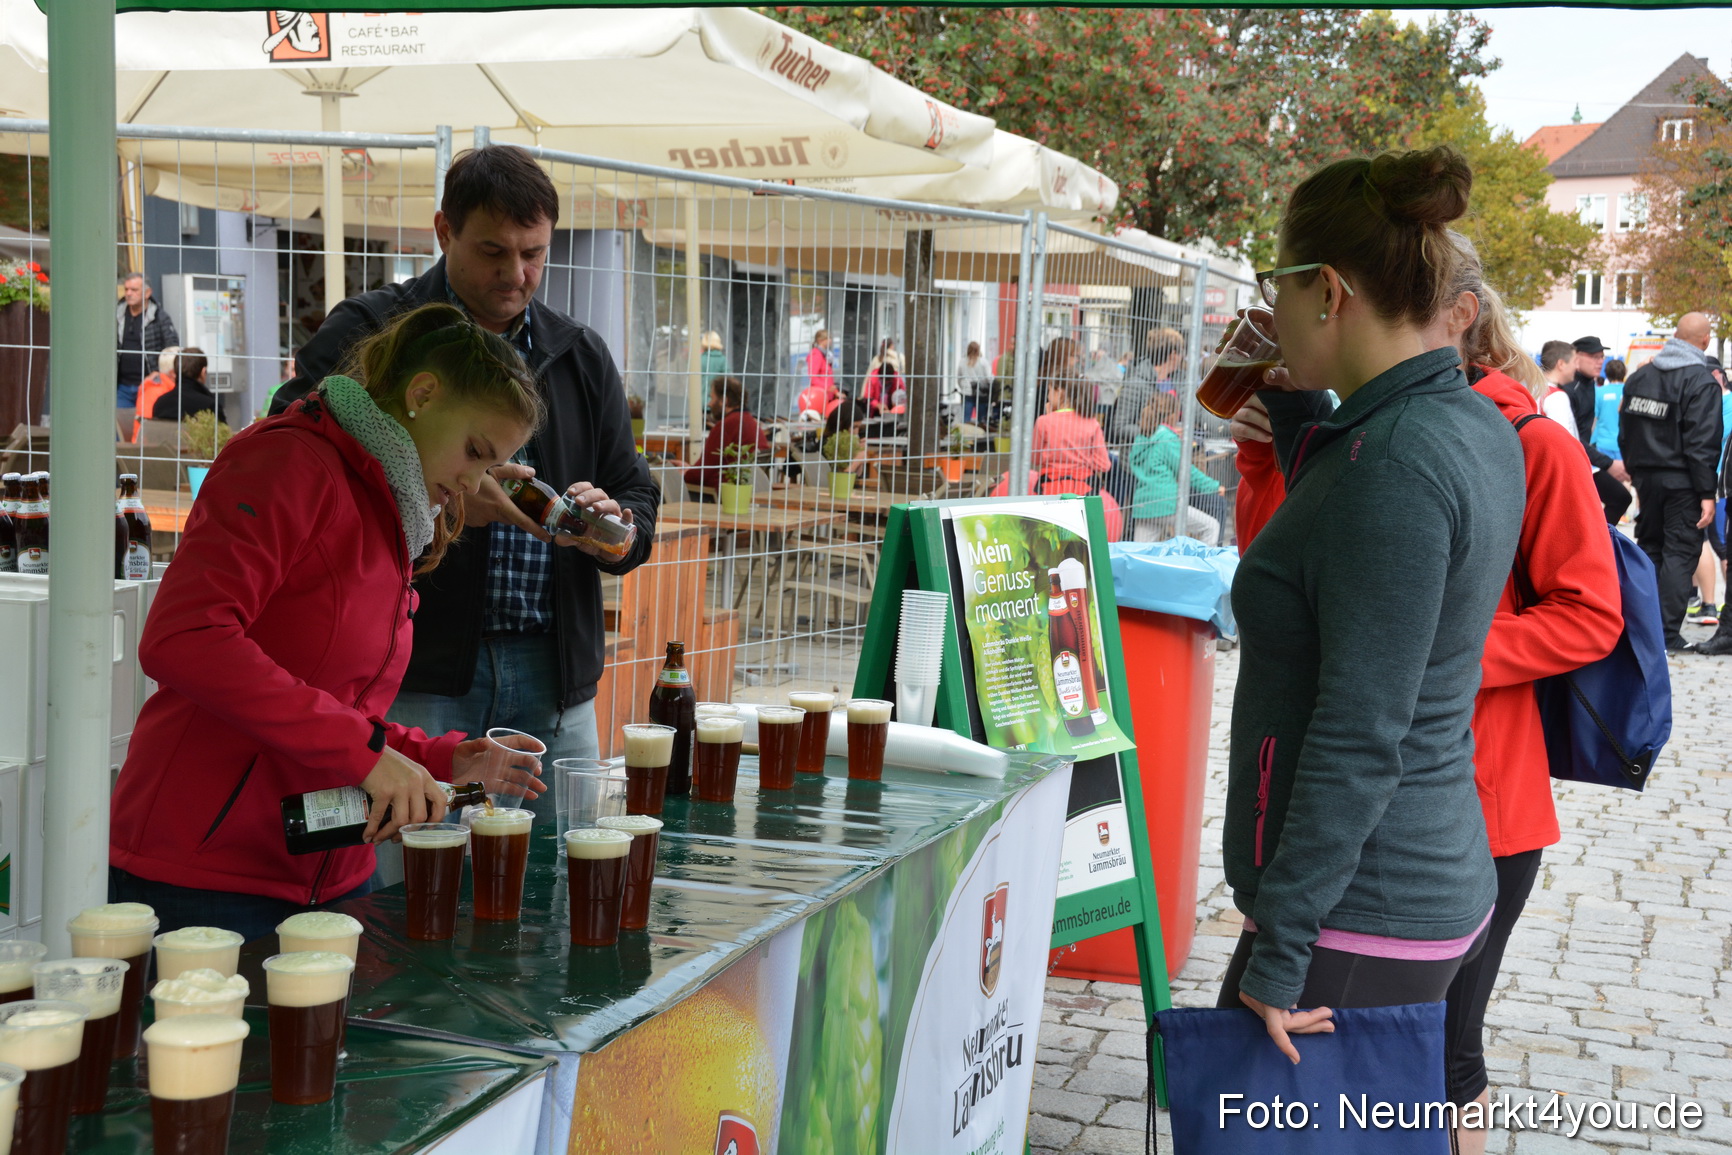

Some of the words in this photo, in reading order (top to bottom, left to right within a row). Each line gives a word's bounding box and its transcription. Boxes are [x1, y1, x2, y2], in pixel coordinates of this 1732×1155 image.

[341, 43, 426, 56] RESTAURANT
[770, 31, 831, 92] Tucher
[1629, 397, 1669, 417] SECURITY
[967, 538, 1012, 566] Mein
[973, 570, 1035, 595] Genuss-
[975, 593, 1042, 623] moment
[1088, 854, 1127, 874] Lammsbräu
[1093, 847, 1120, 860] Neumarkter
[1051, 896, 1131, 935] ammsbraeu.de
